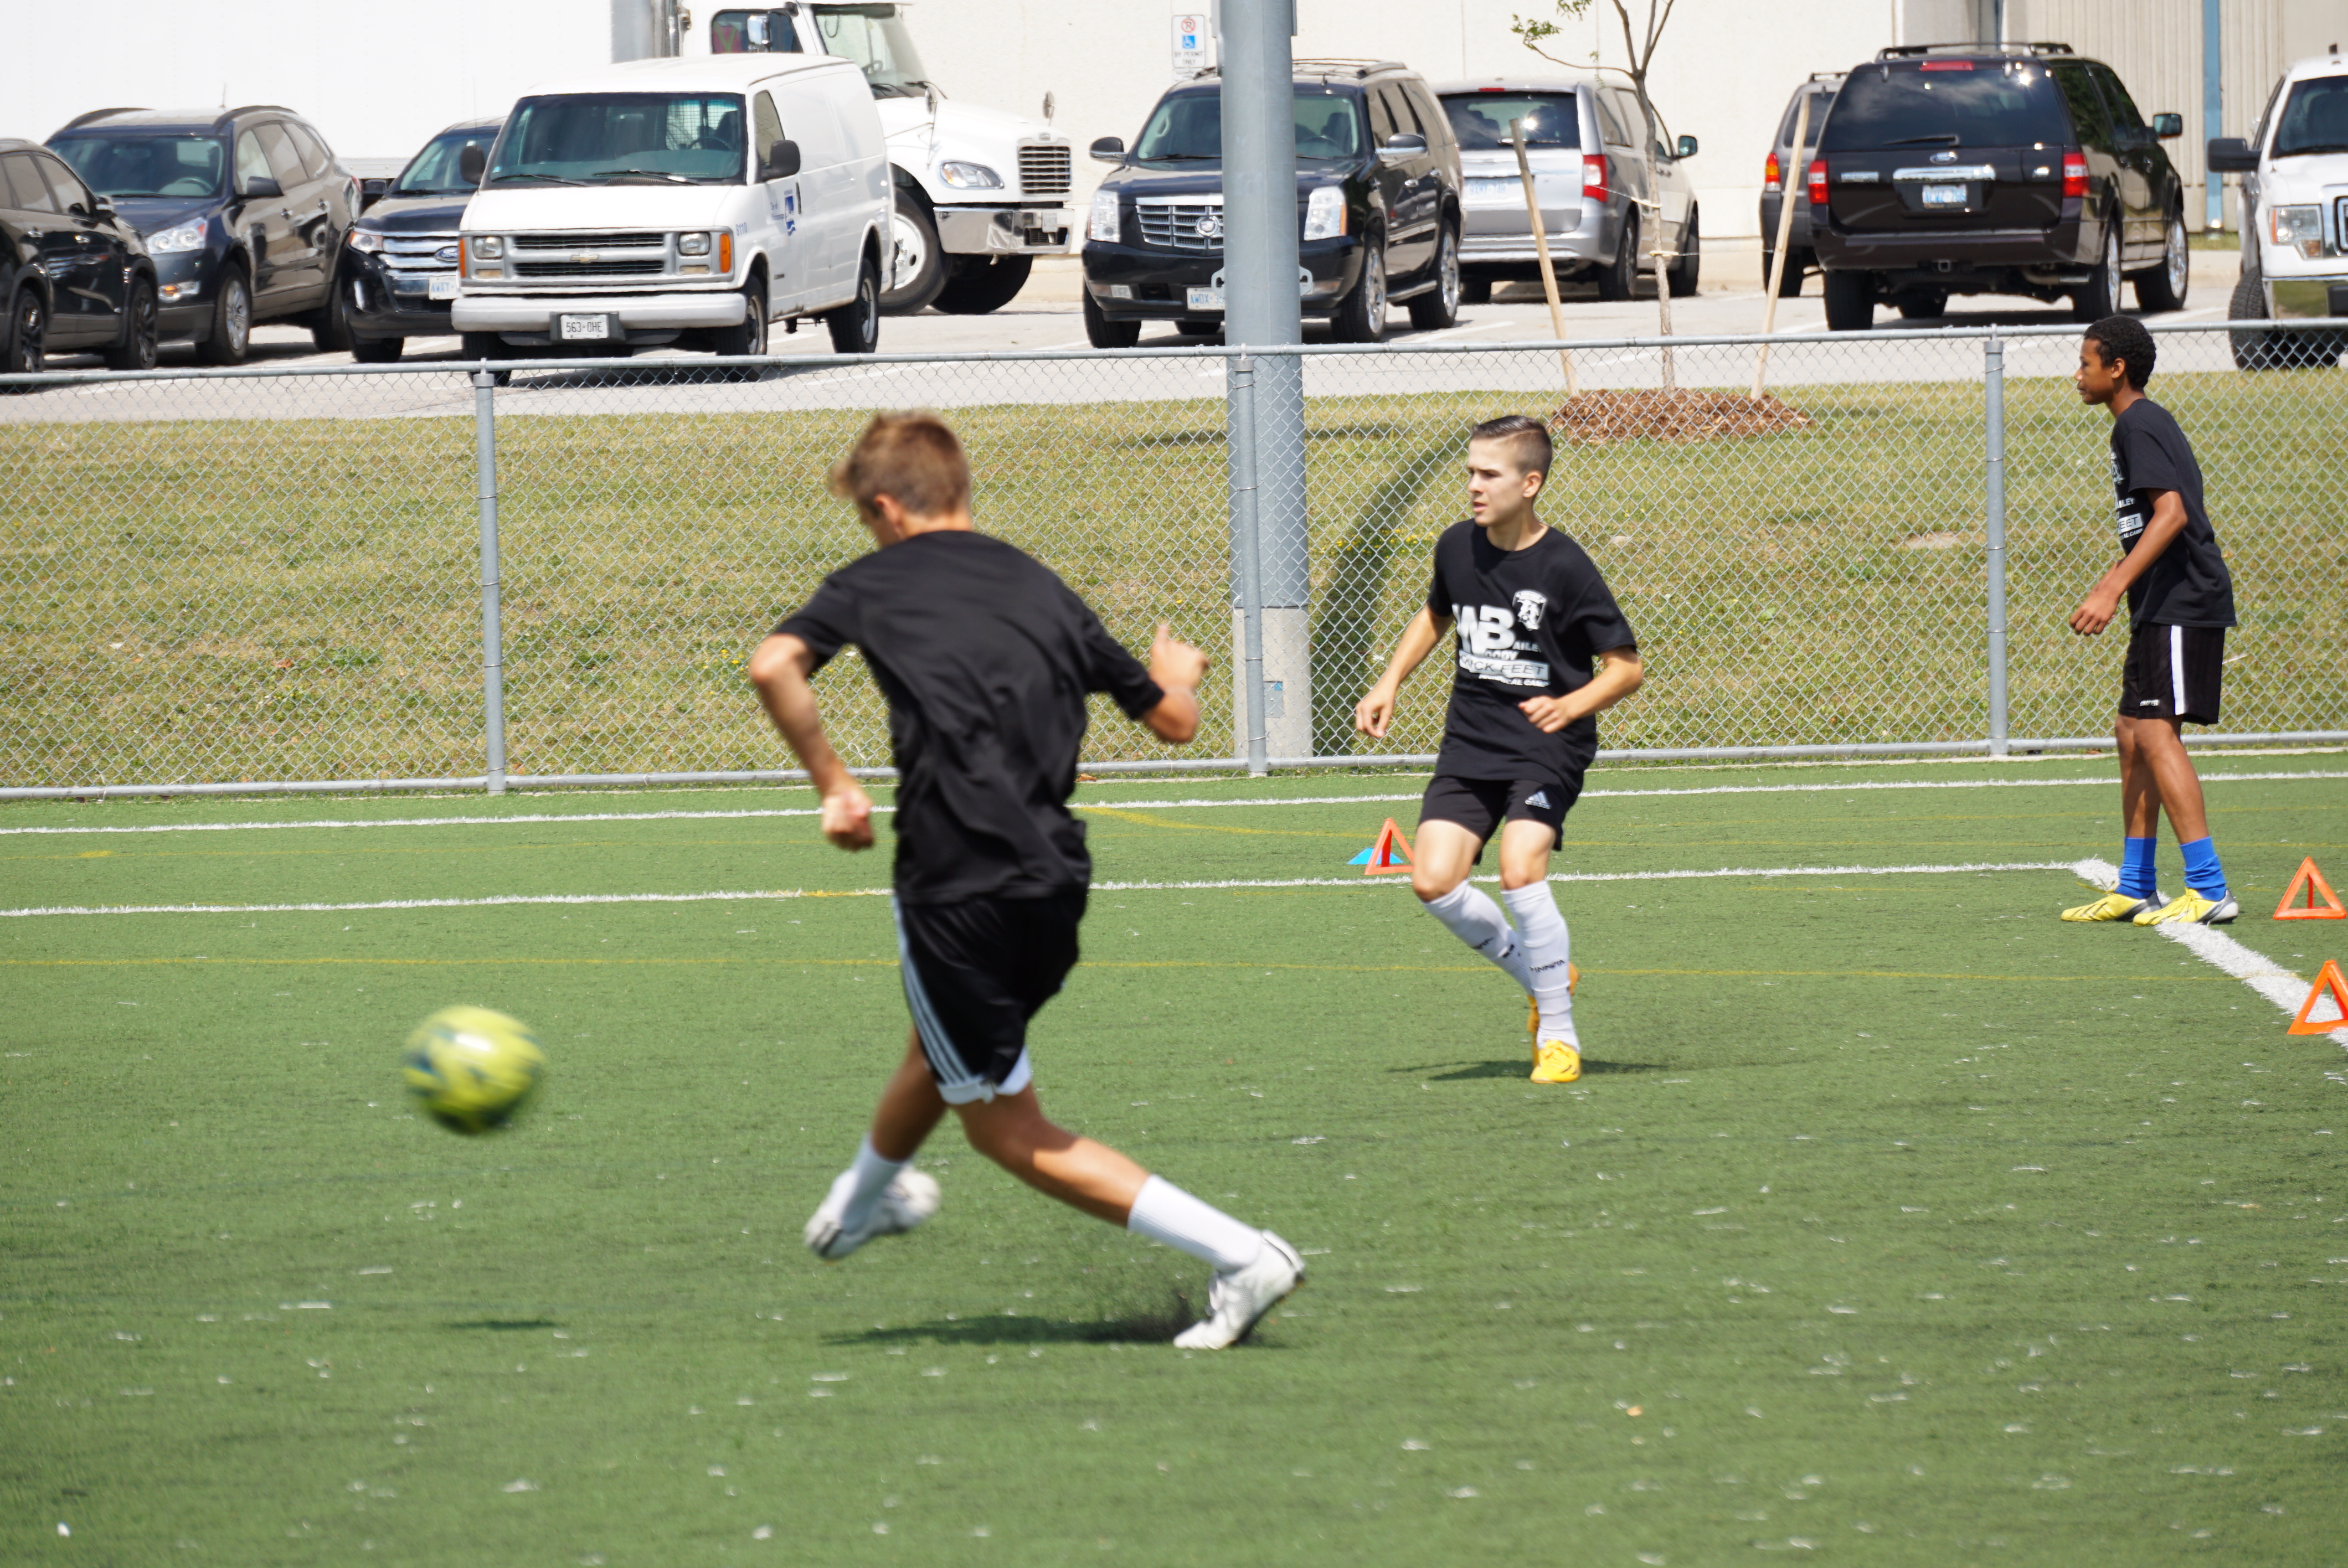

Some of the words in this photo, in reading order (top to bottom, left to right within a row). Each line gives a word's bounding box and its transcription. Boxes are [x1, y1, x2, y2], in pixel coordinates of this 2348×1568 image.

[735, 222, 748, 236] 8110
[566, 322, 581, 332] 563
[1501, 664, 1544, 675] FEET
